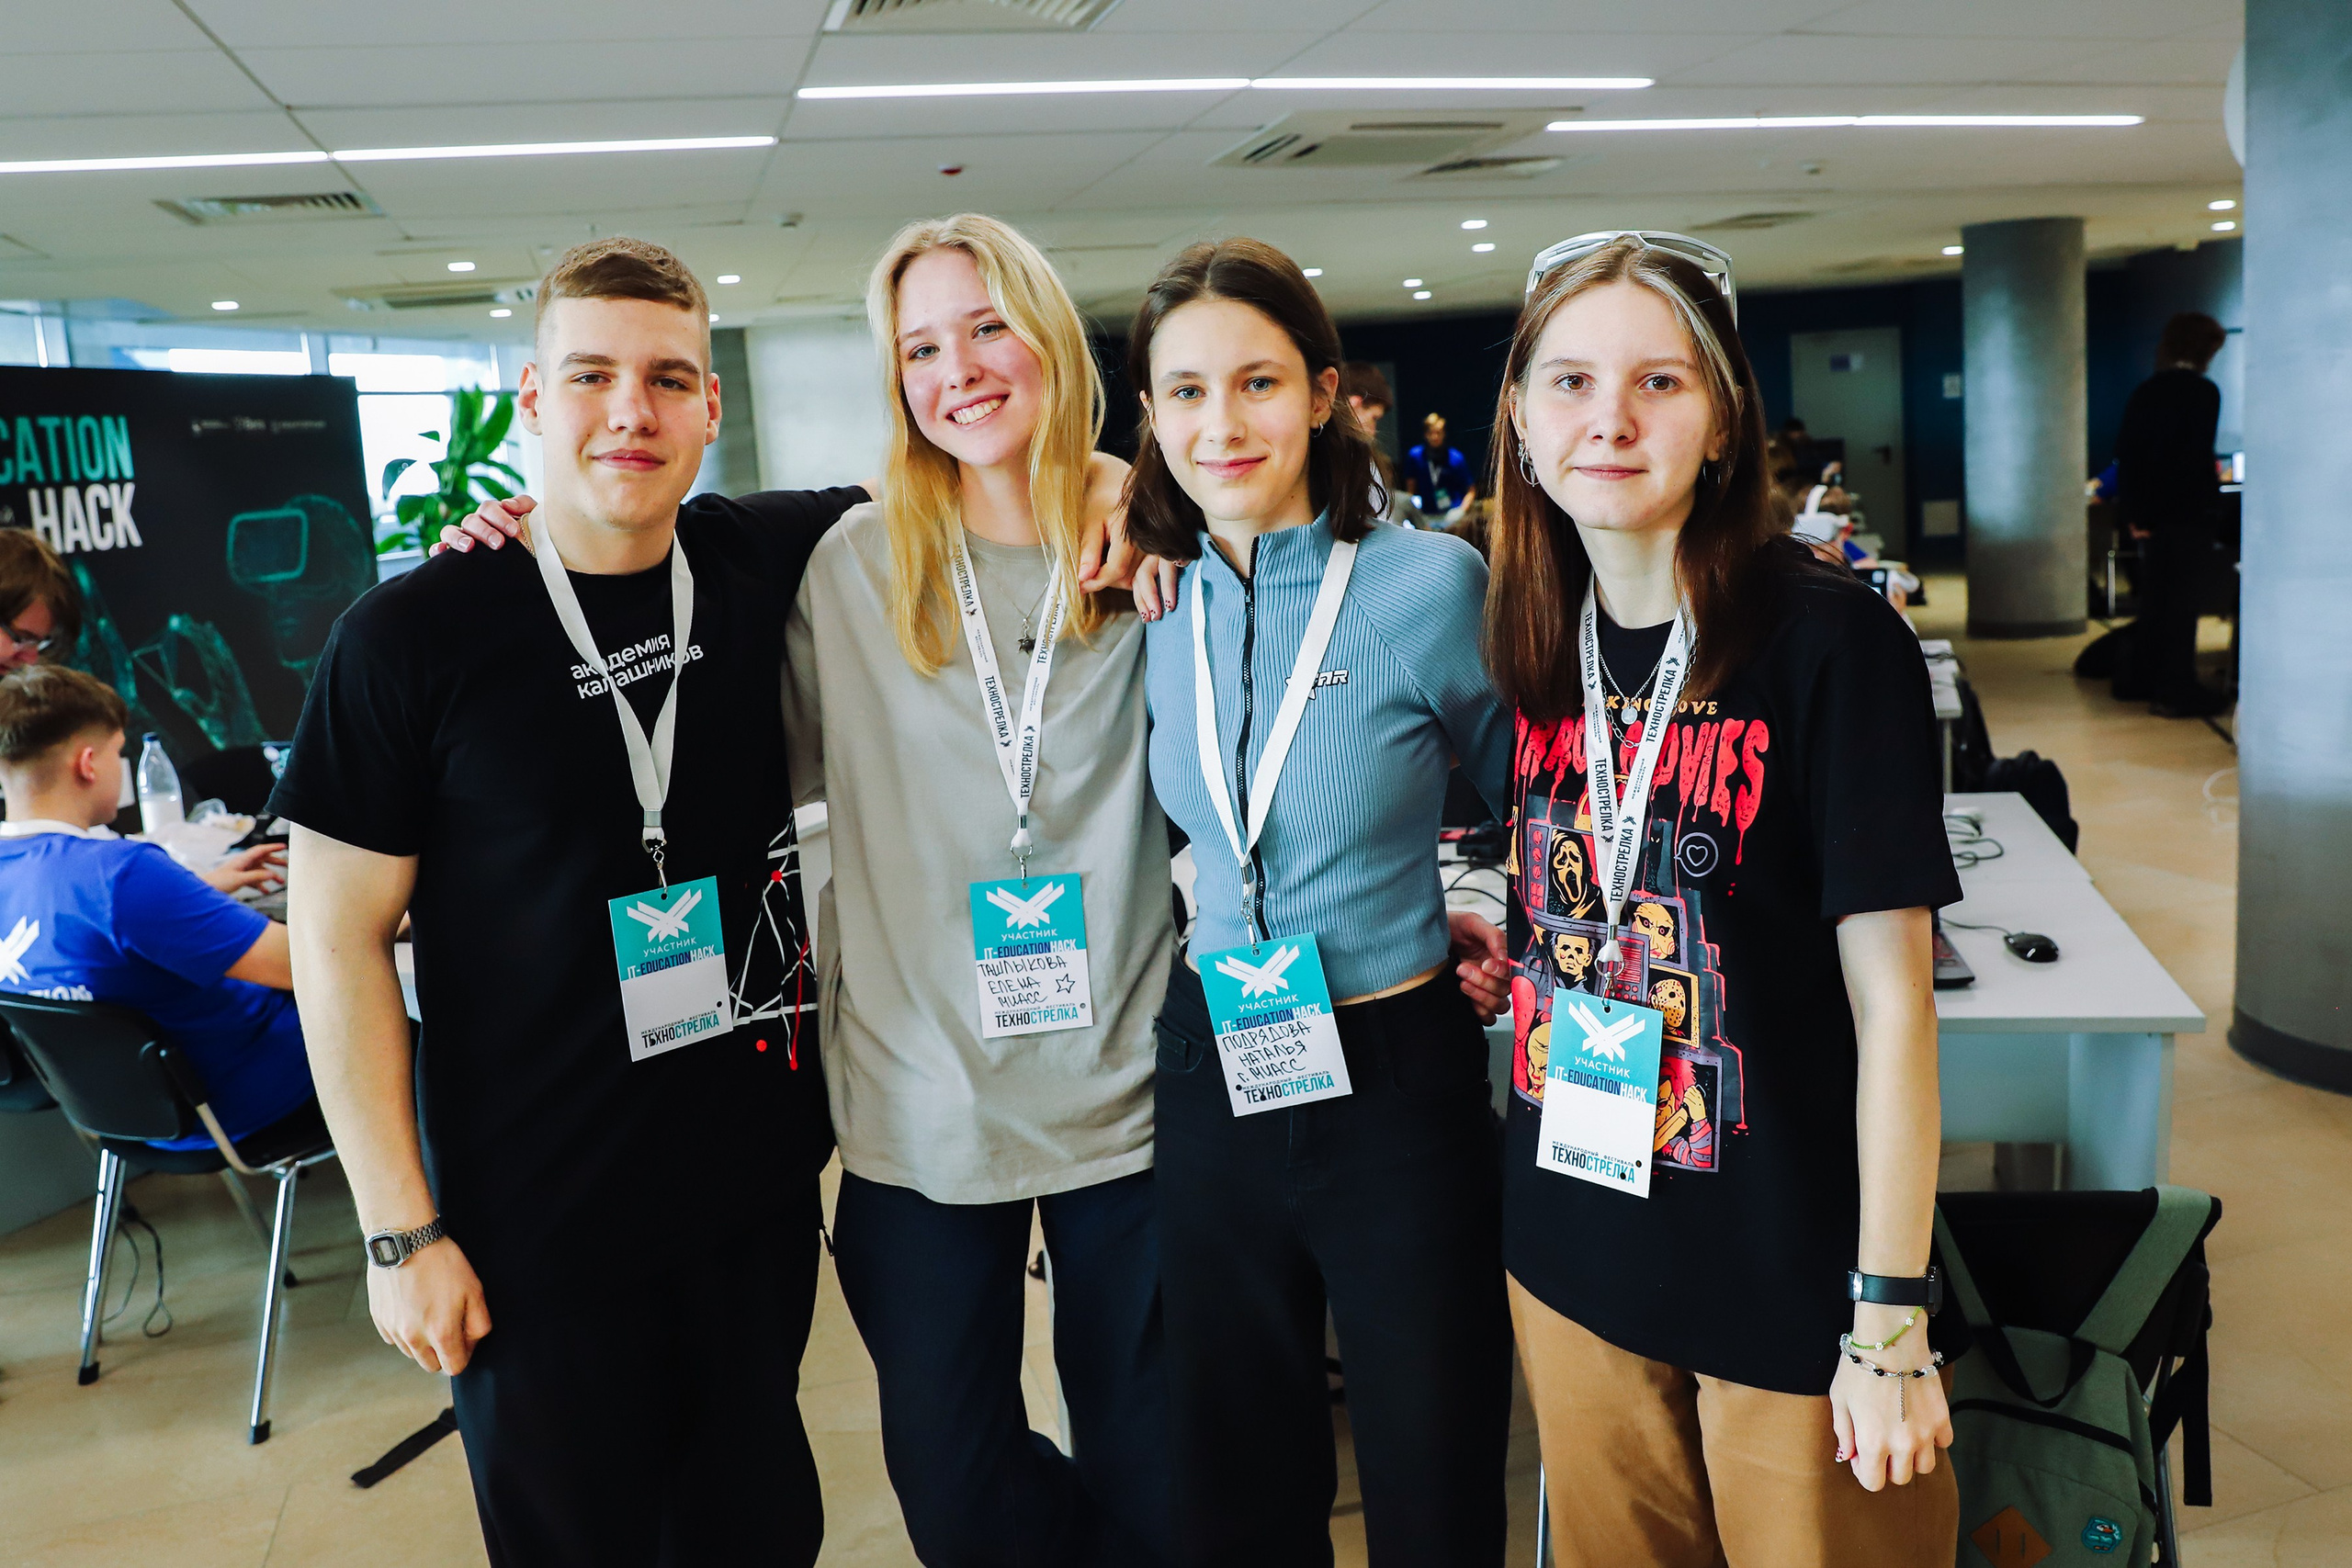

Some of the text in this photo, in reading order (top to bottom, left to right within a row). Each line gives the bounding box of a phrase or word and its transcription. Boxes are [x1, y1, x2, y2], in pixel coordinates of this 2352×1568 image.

[28, 481, 143, 555] HACK
[1585, 610, 1595, 681] ТЕХНОСТРЕЛКА
[984, 675, 1009, 739] ТЕХНОСТРЕЛКА
[1645, 669, 1678, 743] ТЕХНОСТРЕЛКА
[1672, 700, 1719, 716] OVE
[1020, 735, 1035, 799] ТЕХНОСТРЕЛКА
[1594, 758, 1612, 832] ТЕХНОСТРЕЛКА
[1610, 828, 1634, 903] ТЕХНОСТРЕЛКА
[643, 936, 697, 958] УЧАСТНИК
[1001, 928, 1058, 942] УЧАСТНИК
[998, 990, 1048, 1009] МИАСС
[1238, 993, 1299, 1013] УЧАСТНИК
[641, 1013, 720, 1049] ТЕХНОСТРЕЛКА
[995, 1006, 1079, 1029] ТЕХНОСТРЕЛКА
[1222, 1021, 1312, 1053] ПОДРЯДОВА
[1238, 1040, 1308, 1067] НАТАЛЬЯ
[1249, 1058, 1306, 1080] МИАСС
[1574, 1055, 1631, 1079] УЧАСТНИК
[1244, 1074, 1335, 1104] ТЕХНОСТРЕЛКА
[1554, 1065, 1648, 1103] IT-EDUCATIONHACK
[1552, 1145, 1635, 1184] ТЕХНОСТРЕЛКА
